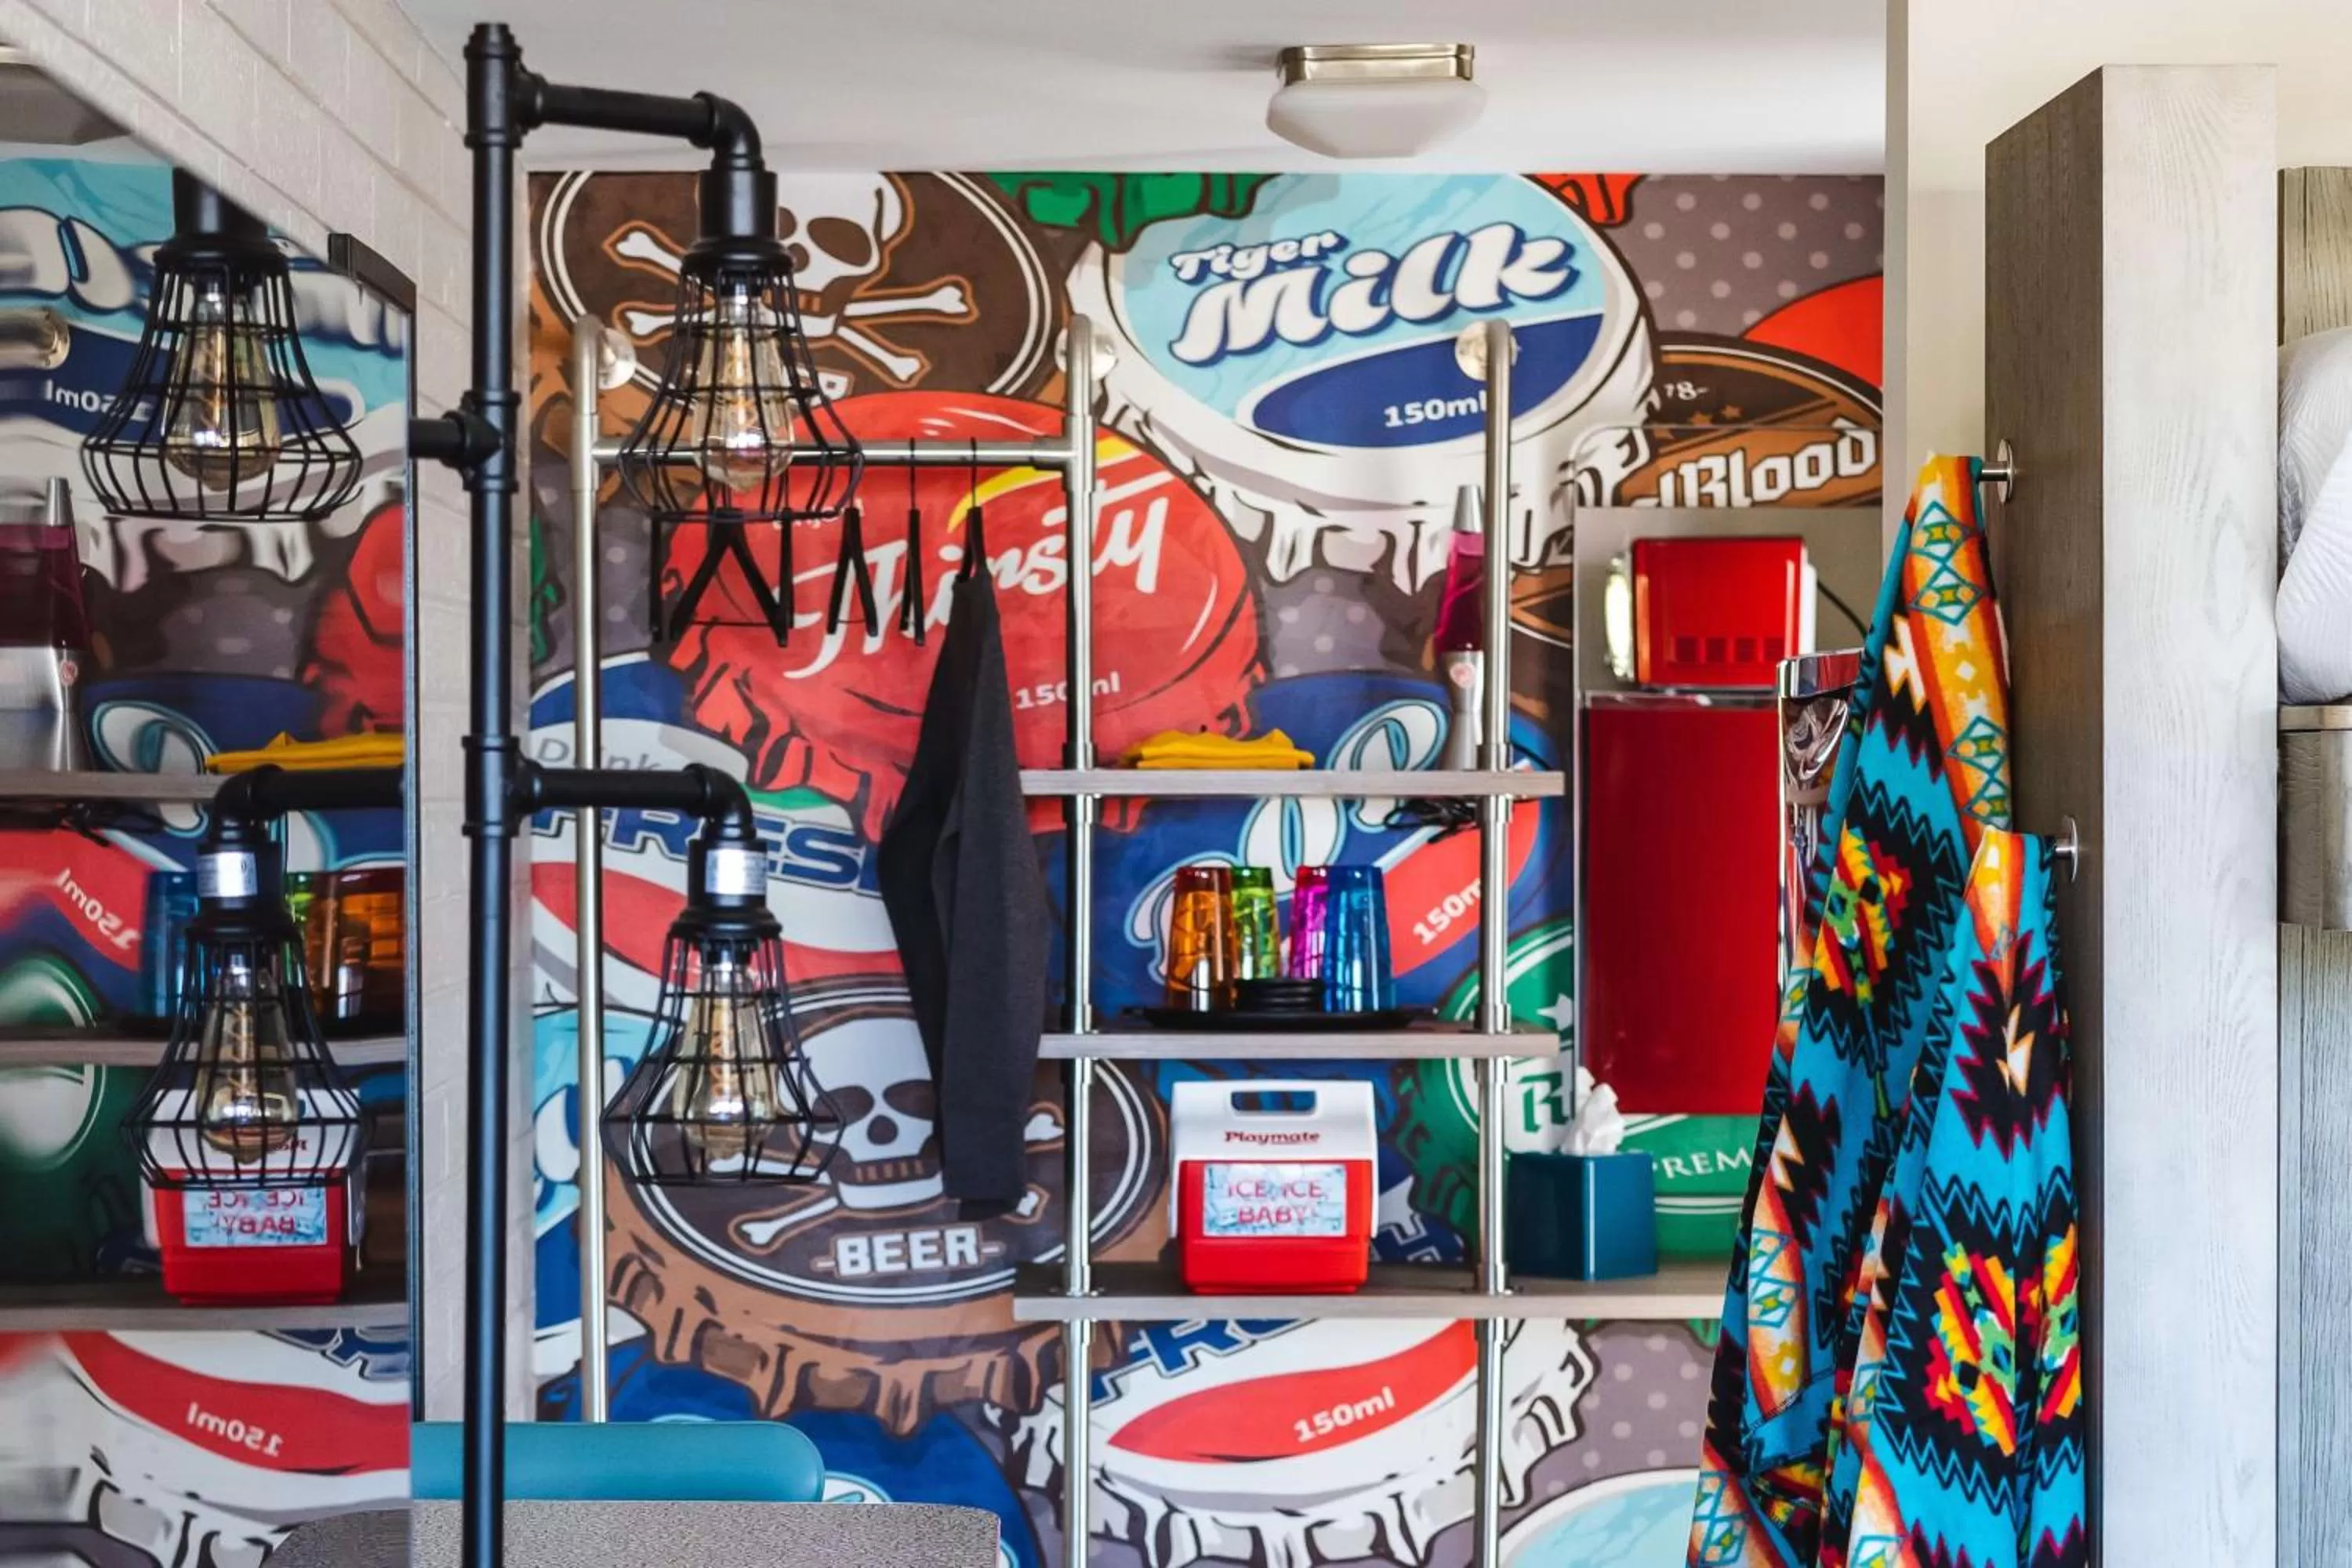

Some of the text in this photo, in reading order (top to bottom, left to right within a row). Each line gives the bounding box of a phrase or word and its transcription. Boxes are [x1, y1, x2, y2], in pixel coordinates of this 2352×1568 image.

[1171, 231, 1347, 282] Tiger
[1170, 223, 1576, 365] Milk
[1383, 390, 1486, 428] 150ml
[536, 737, 662, 771] Dnk
[1413, 877, 1481, 946] 150m
[1225, 1131, 1320, 1145] Playmate
[1294, 1385, 1396, 1443] 150ml
